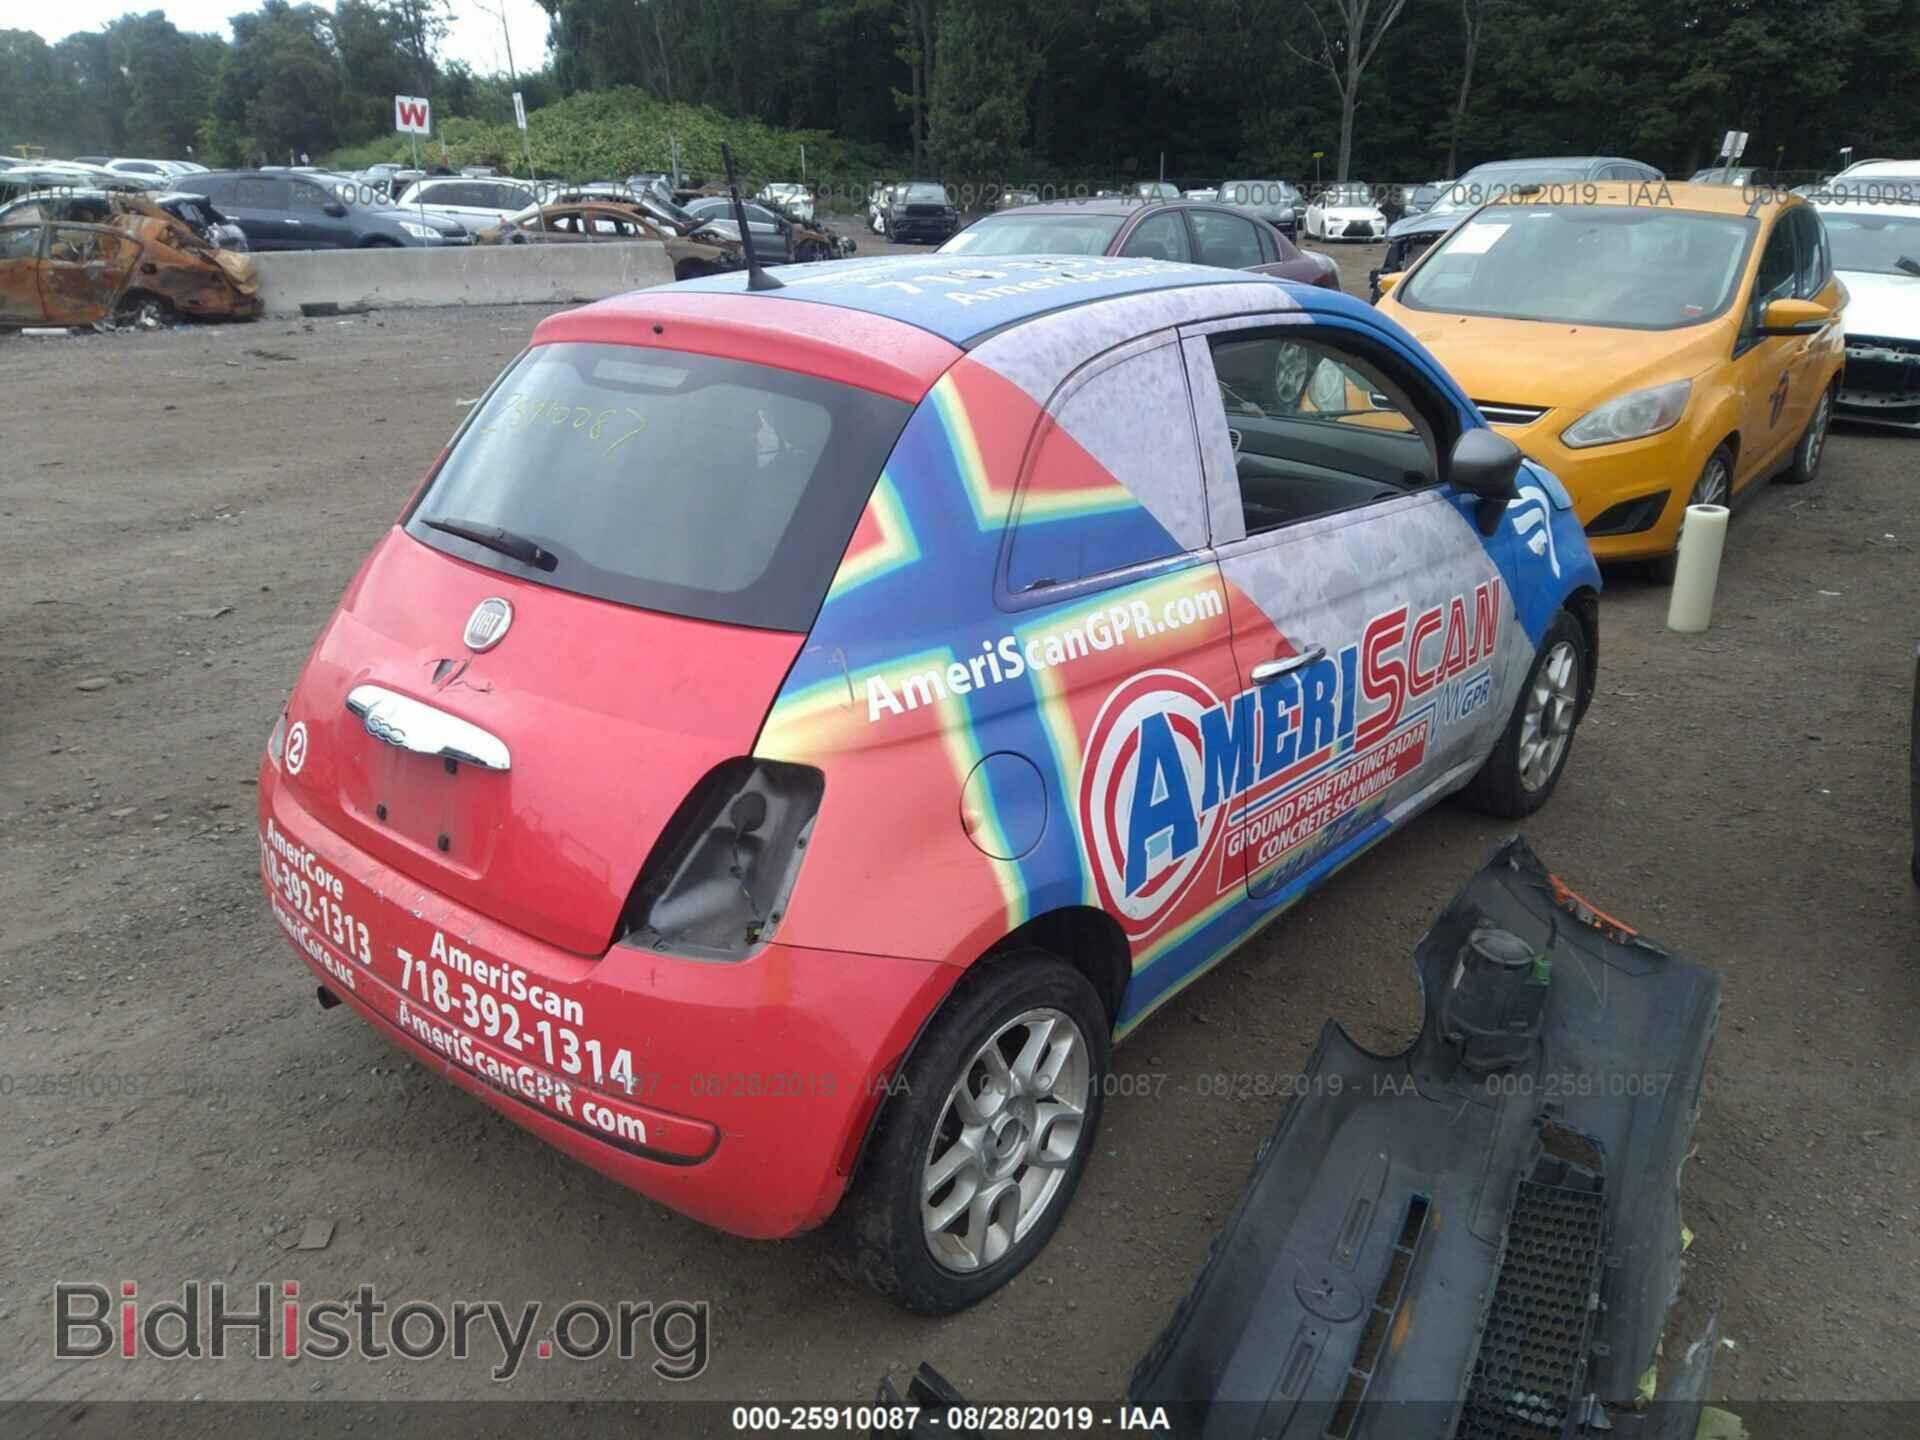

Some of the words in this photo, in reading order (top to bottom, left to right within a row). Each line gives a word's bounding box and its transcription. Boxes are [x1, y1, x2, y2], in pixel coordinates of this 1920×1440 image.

[398, 101, 427, 127] W
[865, 587, 1224, 723] AmeriScanGPR.com
[1461, 677, 1490, 718] GPR
[288, 730, 302, 765] 2
[1228, 802, 1294, 857] GROUND
[1297, 749, 1387, 817] PENETRATING
[1386, 722, 1426, 762] RADAR
[267, 817, 343, 901] AmeriCore
[1258, 808, 1333, 864] CONCRETE
[1333, 762, 1396, 818] SCANNING
[397, 947, 634, 1095] 718-392-1314
[430, 931, 584, 1026] AmeriScan
